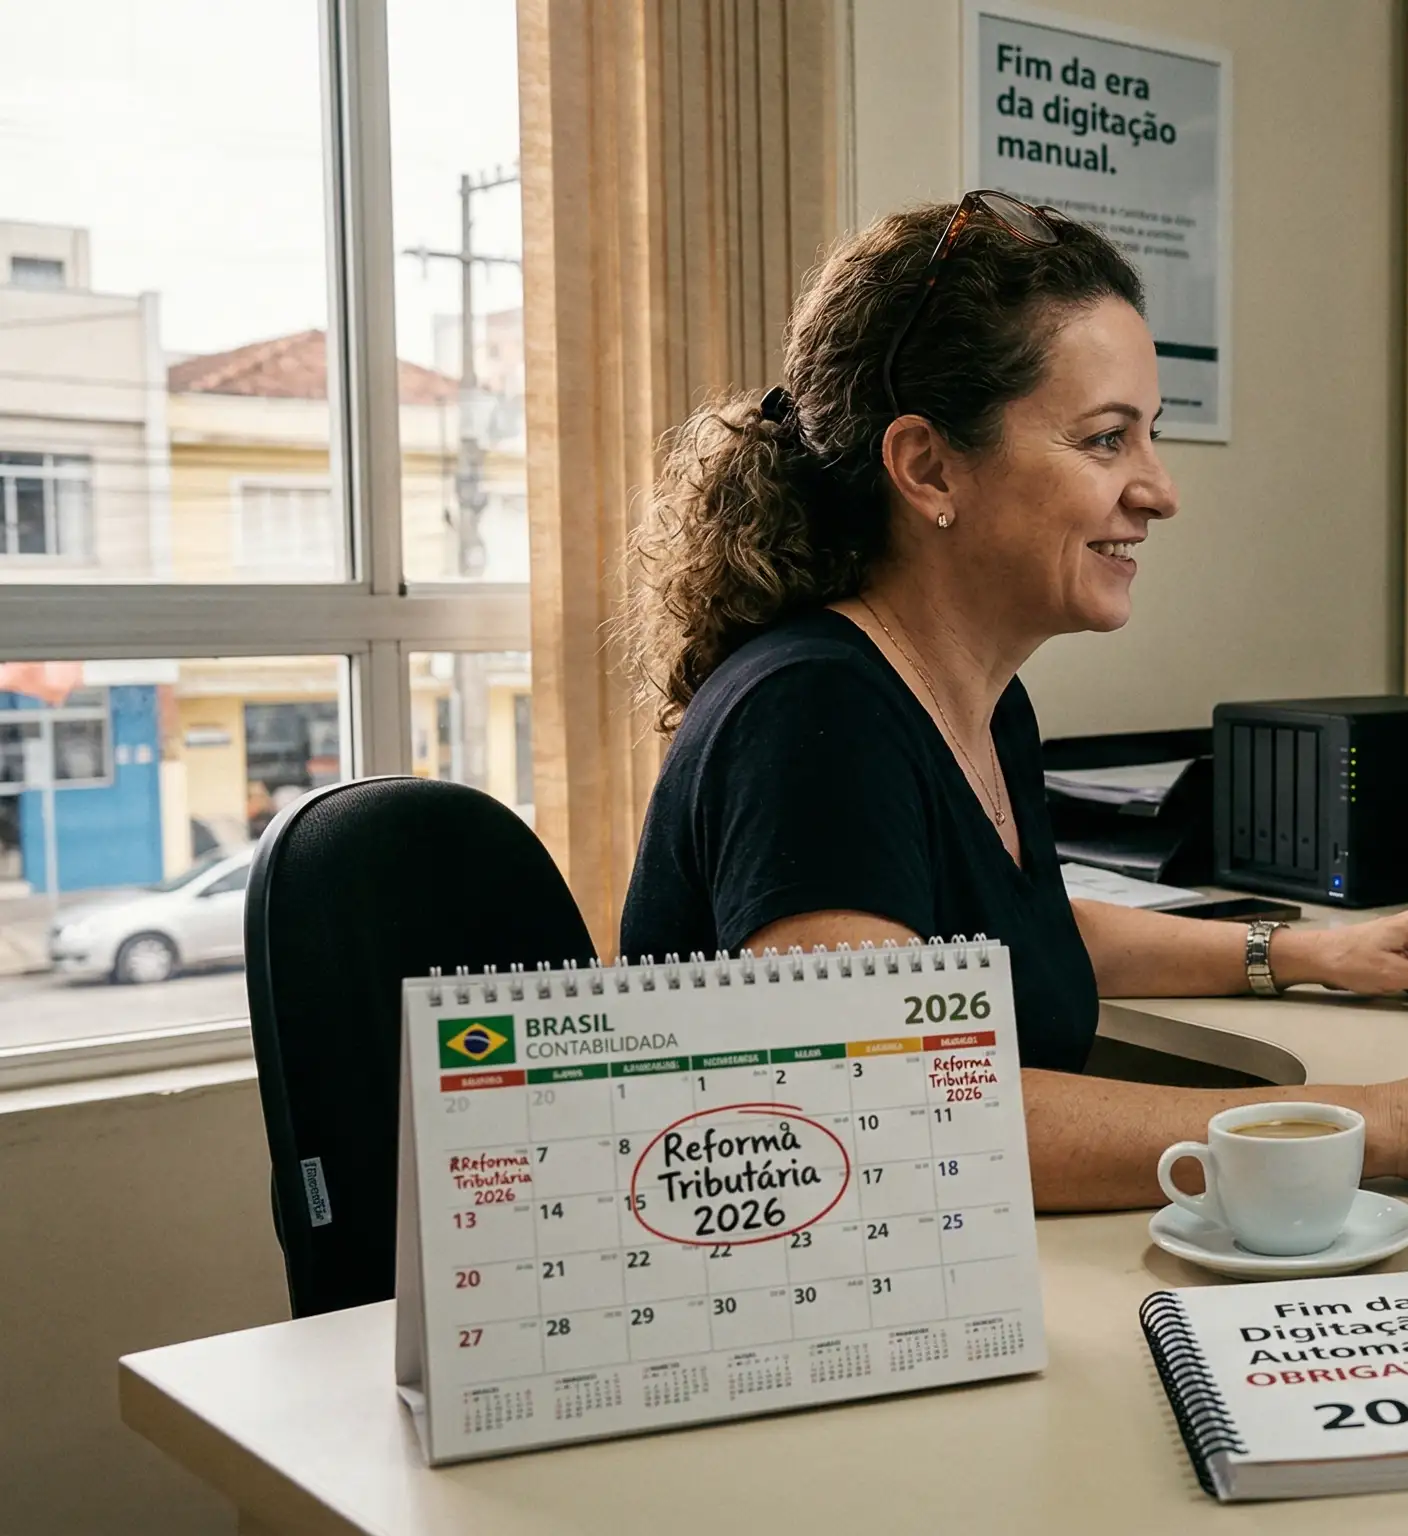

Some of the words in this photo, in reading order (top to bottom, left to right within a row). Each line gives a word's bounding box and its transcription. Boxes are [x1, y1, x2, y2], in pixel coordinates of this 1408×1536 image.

[997, 43, 1052, 82] Fim
[1060, 56, 1096, 90] da
[1105, 73, 1150, 101] era
[996, 85, 1034, 119] da
[1042, 94, 1177, 147] digitação
[996, 134, 1118, 175] manual.
[903, 991, 992, 1025] 2026
[525, 1013, 615, 1038] BRASIL
[525, 1032, 679, 1060] CONTABILIDADA
[853, 1062, 864, 1078] 3
[933, 1055, 992, 1072] Reforma
[697, 1076, 706, 1092] 1
[775, 1069, 787, 1086] 2
[928, 1069, 998, 1089] Tributária
[616, 1083, 626, 1100] 1
[946, 1086, 982, 1102] 2026
[858, 1114, 879, 1131] 10
[934, 1107, 953, 1124] 11
[536, 1147, 548, 1163] 7
[618, 1138, 631, 1155] 8
[663, 1128, 801, 1168] Reforma
[862, 1168, 884, 1185] 17
[938, 1159, 959, 1177] 18
[657, 1158, 821, 1202] Tributária
[474, 1187, 516, 1206] 2026
[624, 1194, 647, 1211] 15
[453, 1211, 477, 1229] 13
[540, 1202, 564, 1220] 14
[694, 1197, 786, 1236] 2026
[867, 1222, 890, 1240] 24
[942, 1213, 964, 1231] 25
[790, 1231, 812, 1249] 23
[626, 1250, 651, 1269] 22
[542, 1260, 566, 1279] 21
[455, 1270, 481, 1289] 20
[872, 1276, 892, 1295] 31
[794, 1286, 817, 1305] 30
[713, 1297, 737, 1315] 30
[1274, 1301, 1353, 1318] Fim
[630, 1306, 655, 1326] 29
[546, 1317, 571, 1337] 28
[458, 1328, 484, 1348] 27
